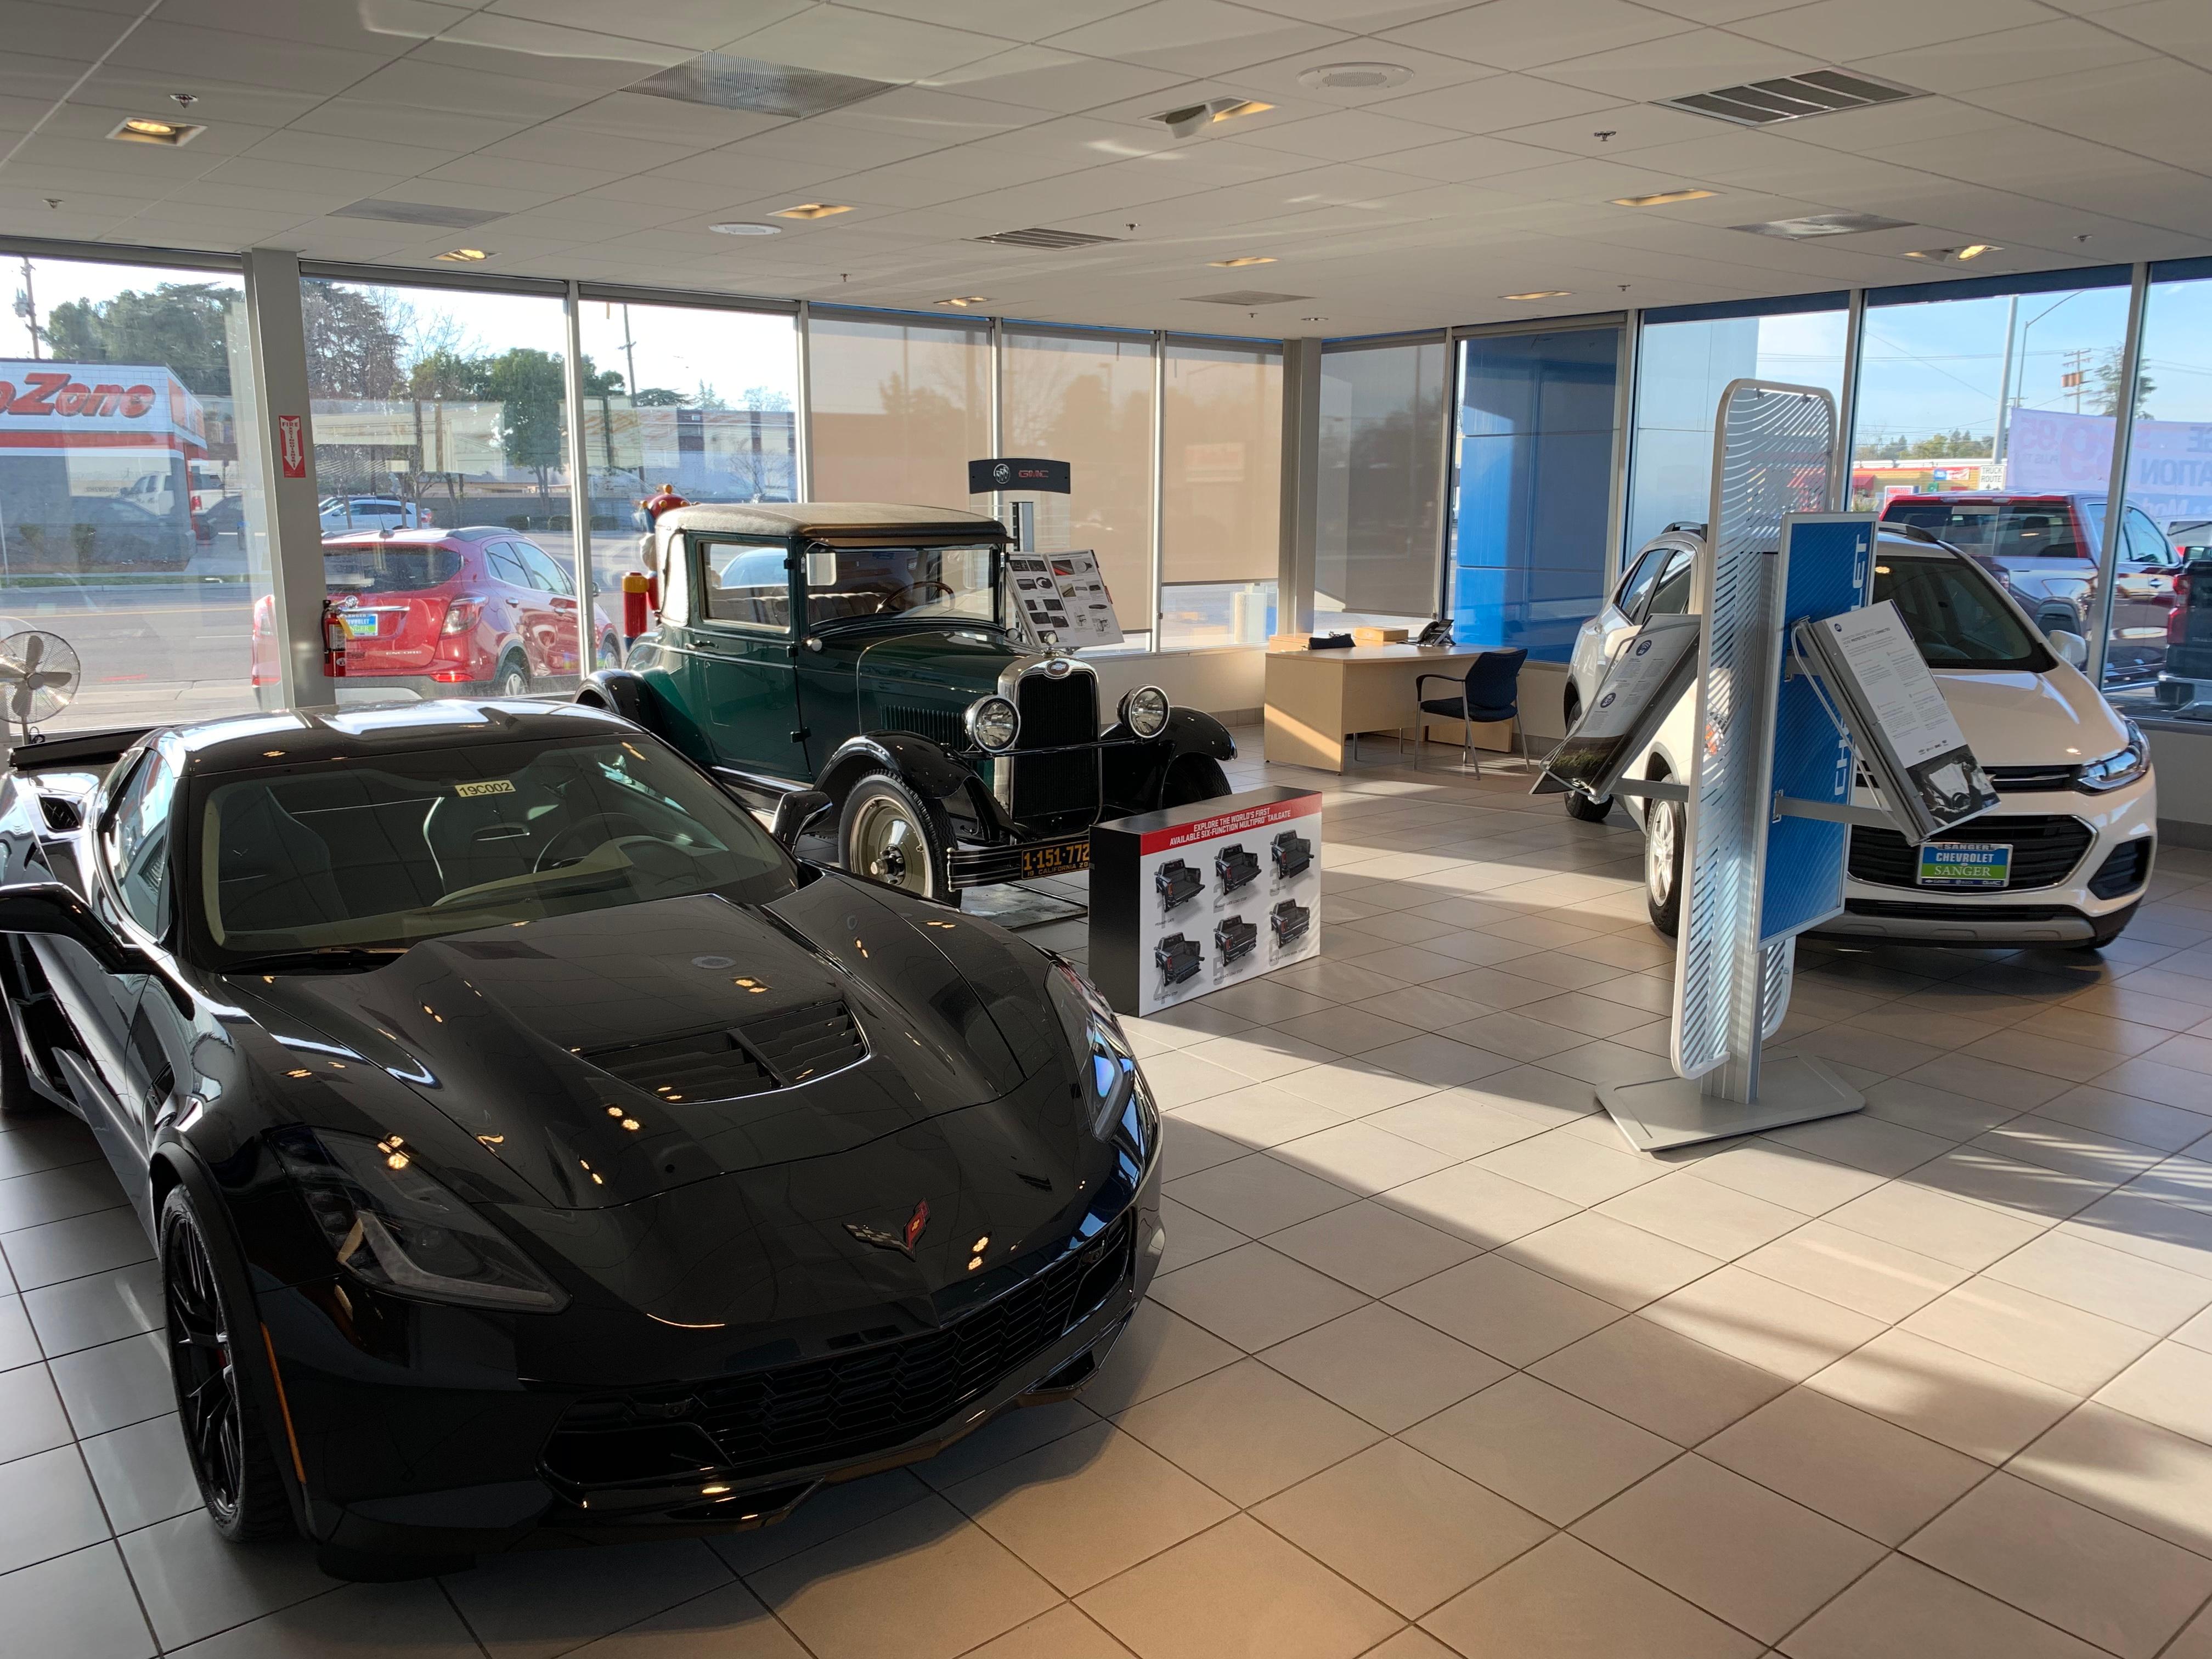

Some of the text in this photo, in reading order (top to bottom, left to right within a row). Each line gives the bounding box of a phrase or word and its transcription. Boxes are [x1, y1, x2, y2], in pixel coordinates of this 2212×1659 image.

[460, 782, 513, 795] 19C002
[1194, 807, 1271, 832] EXPLORE THE WORLD'S FIRST
[1169, 831, 1200, 846] AVAILABLE
[1200, 822, 1238, 838] SIX-FUNCTION
[1267, 810, 1291, 822] TAILGATE
[1936, 853, 1995, 863] CHEVROLET
[1038, 864, 1076, 874] CALIFORNIA
[1934, 866, 1991, 876] SANGER
